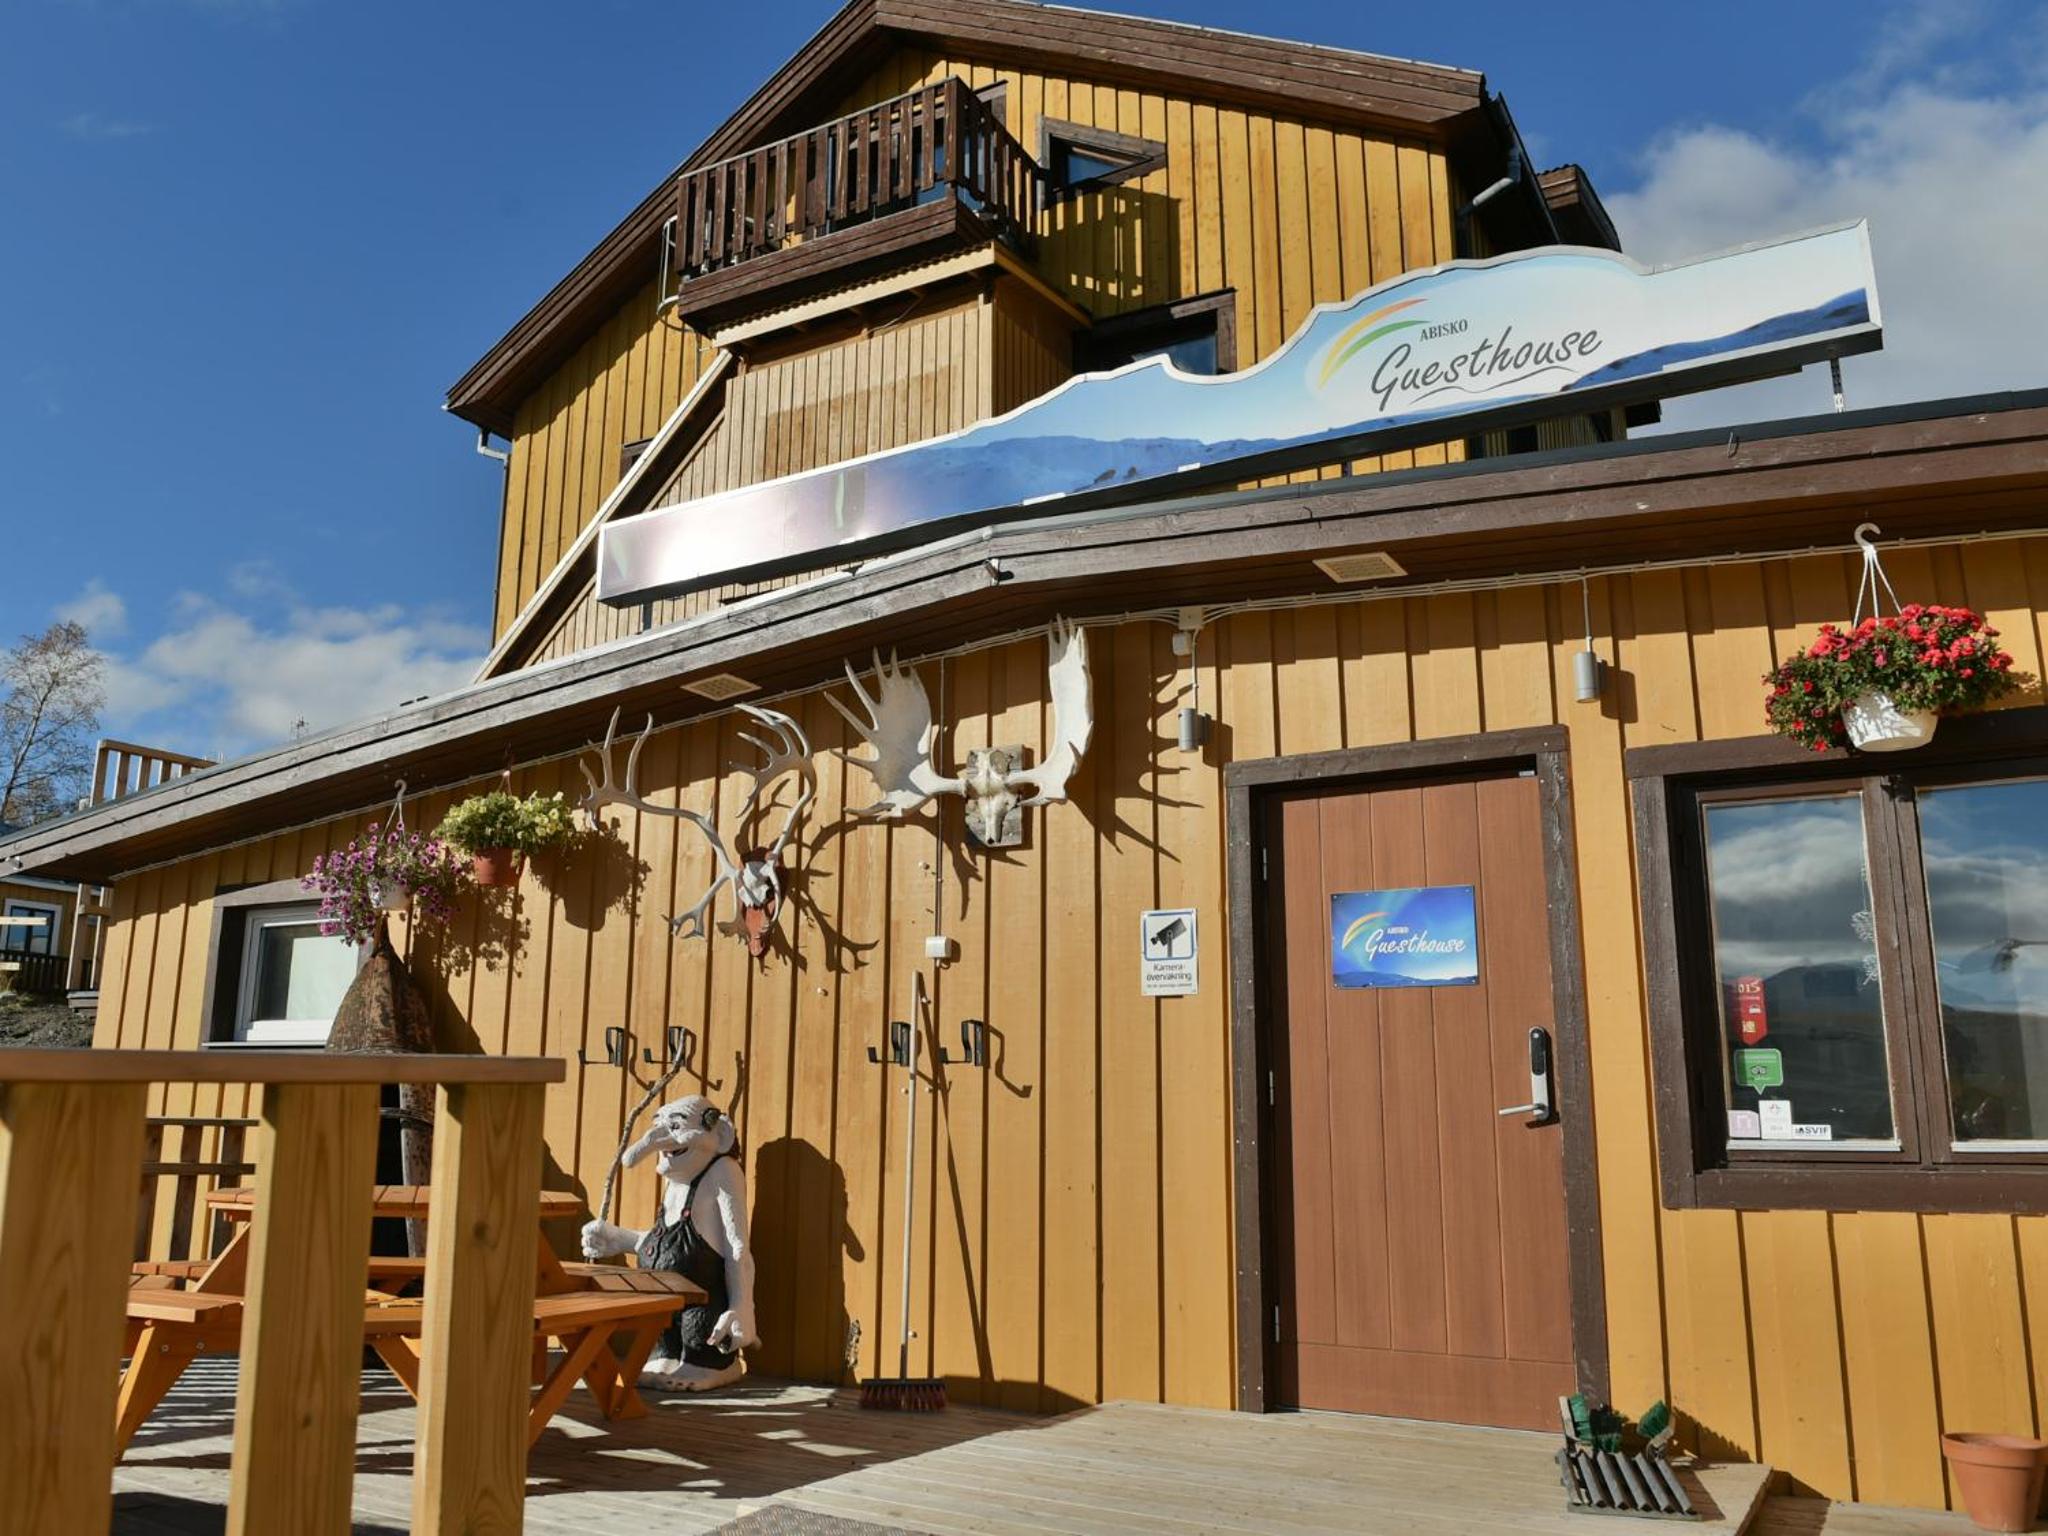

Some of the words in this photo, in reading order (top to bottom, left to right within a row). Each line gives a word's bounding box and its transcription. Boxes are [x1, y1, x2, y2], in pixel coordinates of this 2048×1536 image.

[1420, 317, 1469, 343] ABISKO
[1371, 326, 1603, 412] Guesthouse
[1365, 928, 1467, 961] Guesthouse
